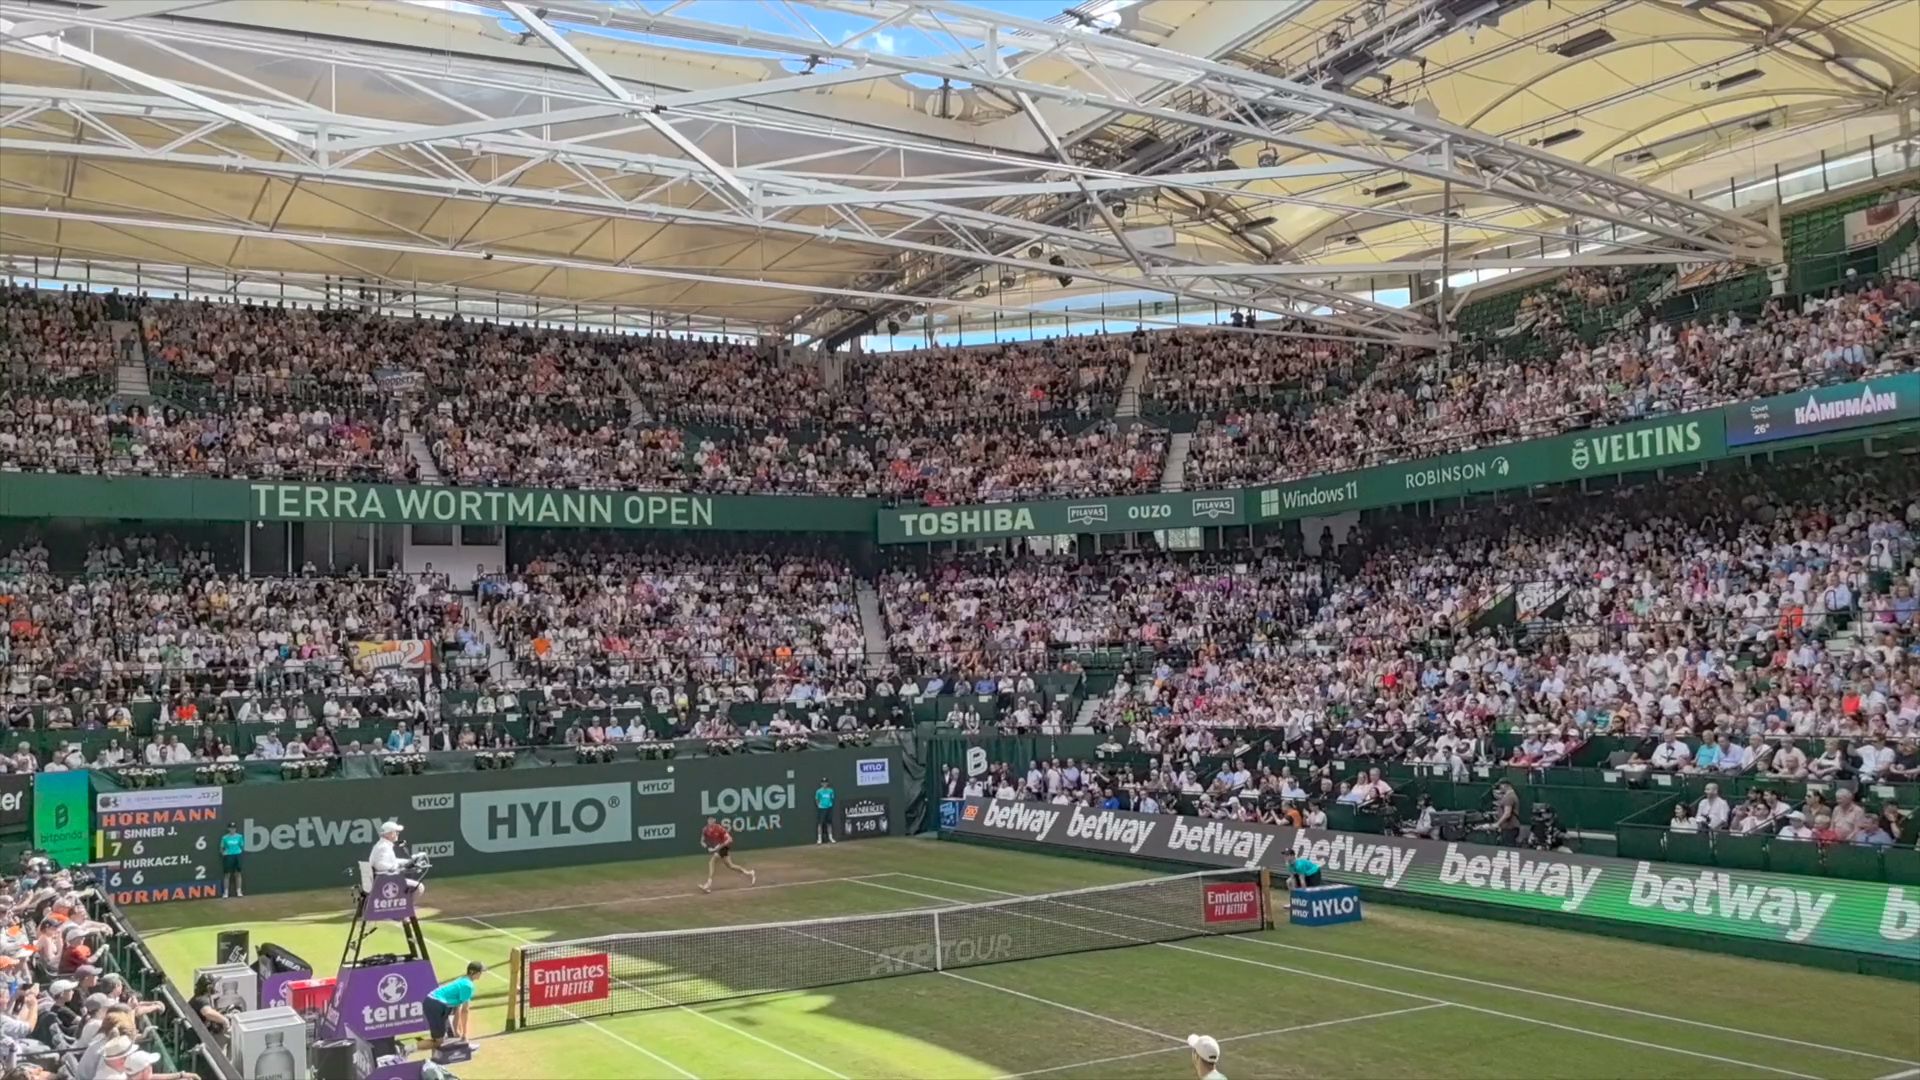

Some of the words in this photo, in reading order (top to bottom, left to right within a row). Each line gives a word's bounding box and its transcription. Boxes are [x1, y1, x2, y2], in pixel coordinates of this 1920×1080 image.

[1750, 405, 1768, 413] Court
[1795, 384, 1897, 425] KAMPMANN
[1754, 423, 1770, 435] 26°
[1592, 421, 1701, 464] VELTINS
[1405, 462, 1486, 489] ROBINSON
[250, 484, 386, 519] TERRA
[395, 489, 612, 524] WORTMANN
[624, 496, 713, 526] OPEN
[1282, 487, 1344, 509] Windows
[1345, 480, 1358, 499] 11
[1070, 507, 1104, 518] PILAVAS
[1128, 505, 1171, 519] OUZO
[1196, 500, 1231, 511] PILAVAS
[900, 508, 1035, 537] TOSHIBA
[721, 814, 781, 832] SOLAR
[856, 820, 876, 831] 1:49
[983, 798, 1059, 841] betway
[1066, 806, 1156, 853] betway
[124, 828, 165, 839] SINNER
[167, 826, 177, 836] J.
[1167, 815, 1274, 868] betway
[112, 843, 122, 857] 7
[133, 842, 144, 855] 6
[195, 836, 207, 850] 6
[123, 858, 178, 869] HURKACZ
[180, 855, 192, 865] H.
[1292, 828, 1417, 888] betway
[110, 871, 122, 887] 6
[132, 870, 144, 885] 6
[195, 866, 206, 880] 2
[1439, 842, 1603, 912] betway
[111, 885, 217, 905] ÖRMANN
[374, 897, 407, 909] terra
[1207, 890, 1254, 905] Emirates
[1628, 861, 1836, 942] betway
[941, 933, 1012, 963] TOUR
[534, 964, 604, 985] Emirates
[545, 983, 560, 999] FLY
[562, 980, 594, 996] BETTER
[362, 1001, 423, 1024] terra
